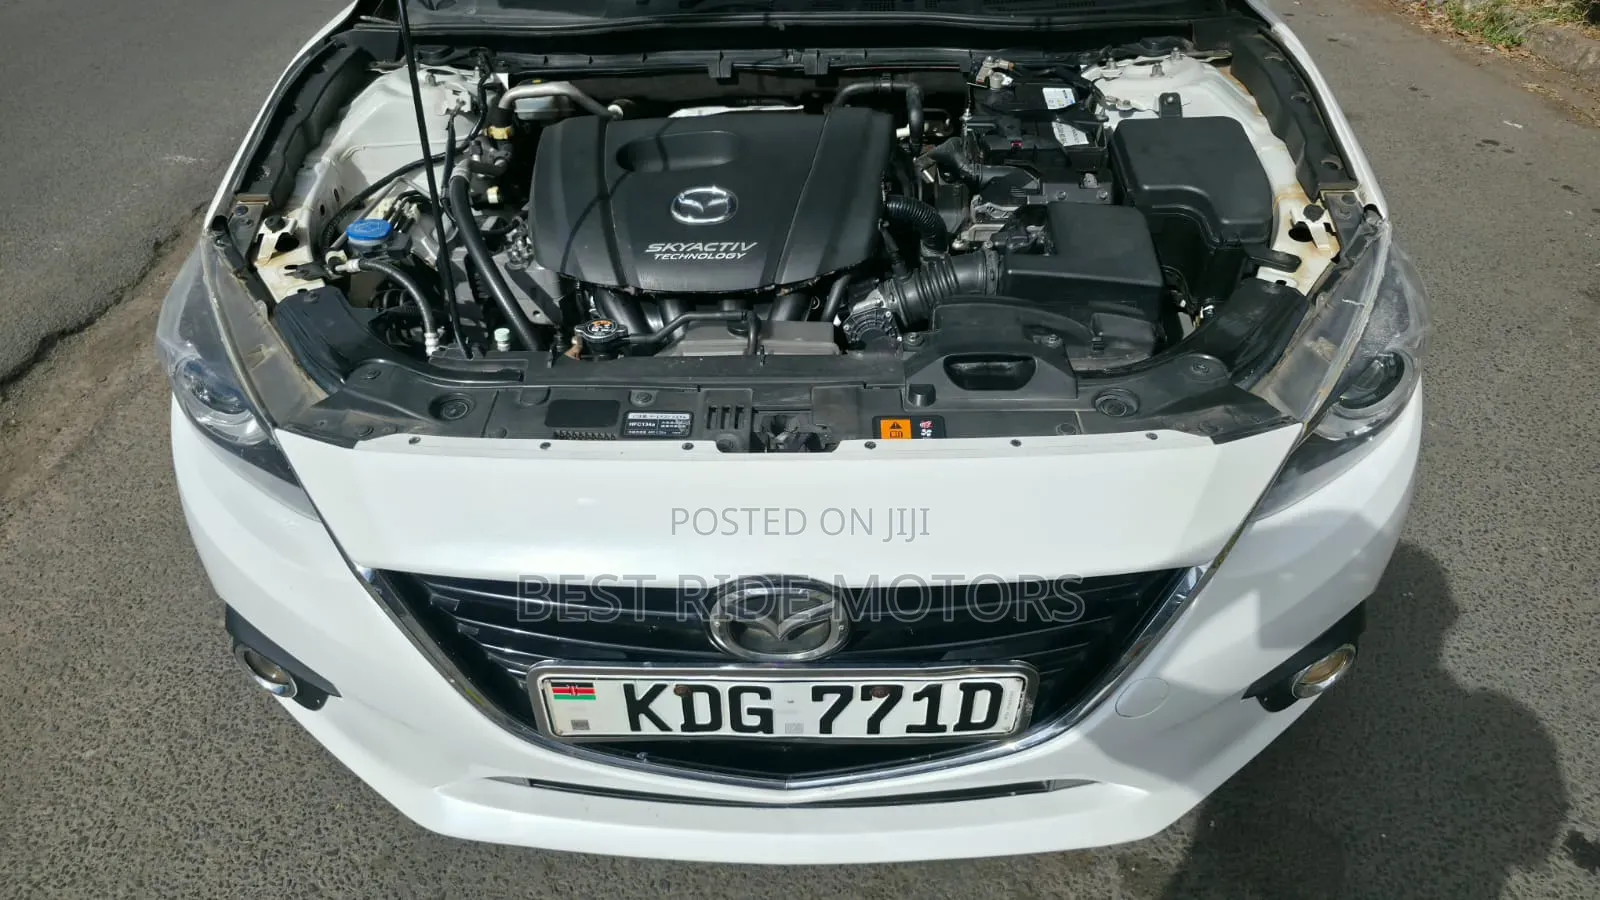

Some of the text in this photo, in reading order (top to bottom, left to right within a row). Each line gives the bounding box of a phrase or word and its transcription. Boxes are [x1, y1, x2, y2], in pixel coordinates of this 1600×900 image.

[645, 242, 758, 253] SKYACTIV
[654, 253, 747, 261] TECHNOLOGY
[623, 683, 774, 734] KDG
[811, 682, 1004, 734] 771D
